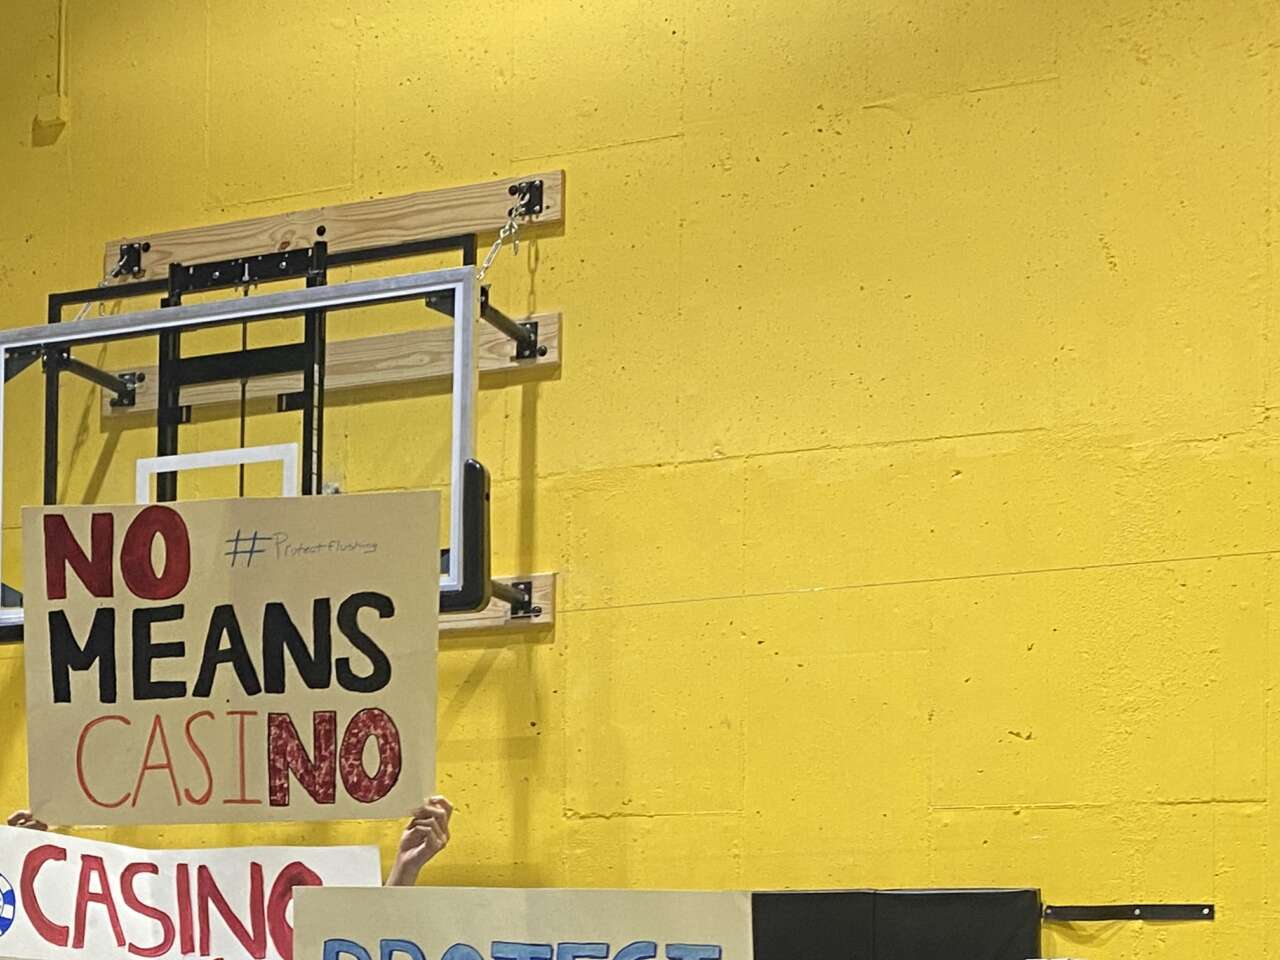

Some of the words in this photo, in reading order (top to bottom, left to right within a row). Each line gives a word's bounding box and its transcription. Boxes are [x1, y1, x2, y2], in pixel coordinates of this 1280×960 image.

[44, 504, 191, 600] NO
[48, 591, 395, 703] MEANS
[76, 707, 402, 809] CASINO
